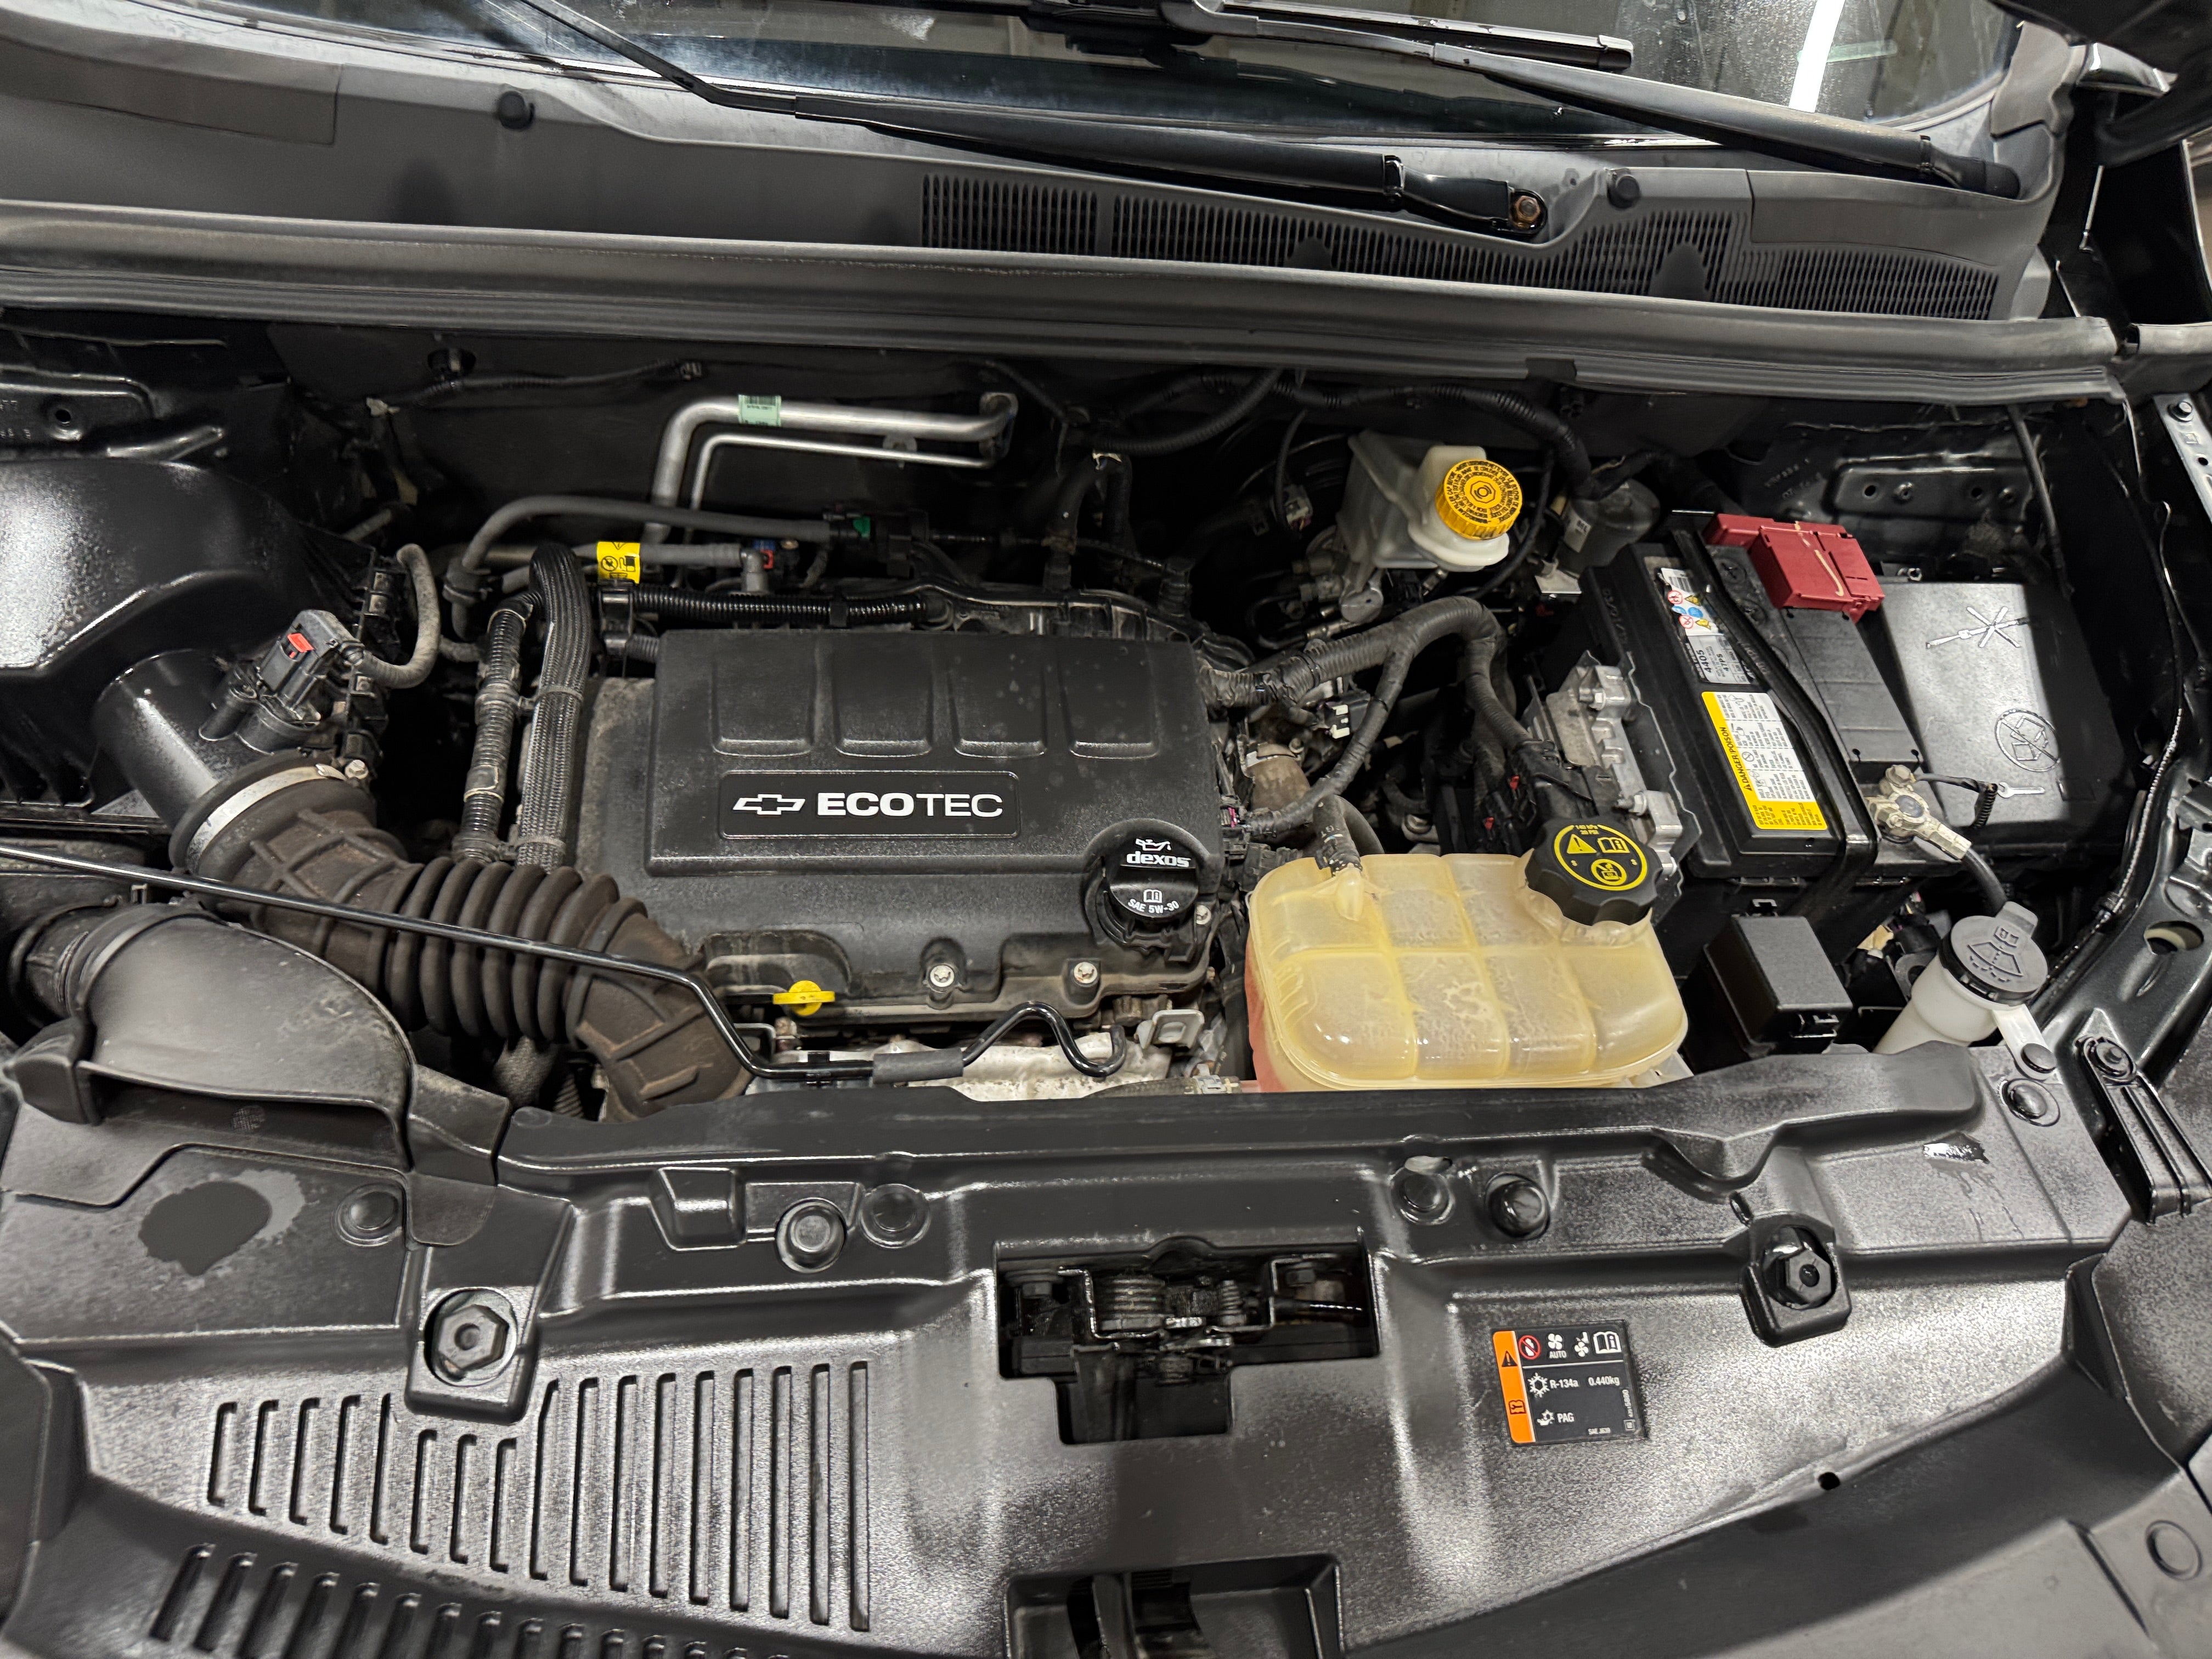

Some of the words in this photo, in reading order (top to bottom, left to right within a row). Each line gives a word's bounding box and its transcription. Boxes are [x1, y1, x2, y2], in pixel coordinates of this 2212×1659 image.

[1696, 650, 1712, 673] 4405
[1718, 726, 1749, 783] DANGER/POISON
[817, 792, 1004, 817] ECOTEC
[1126, 851, 1191, 867] dexos
[1128, 899, 1146, 912] SAE
[1148, 900, 1180, 913] 5W-30
[1549, 1378, 1579, 1389] R-134a
[1588, 1376, 1621, 1386] 0.440kg
[1557, 1412, 1575, 1423] PAG
